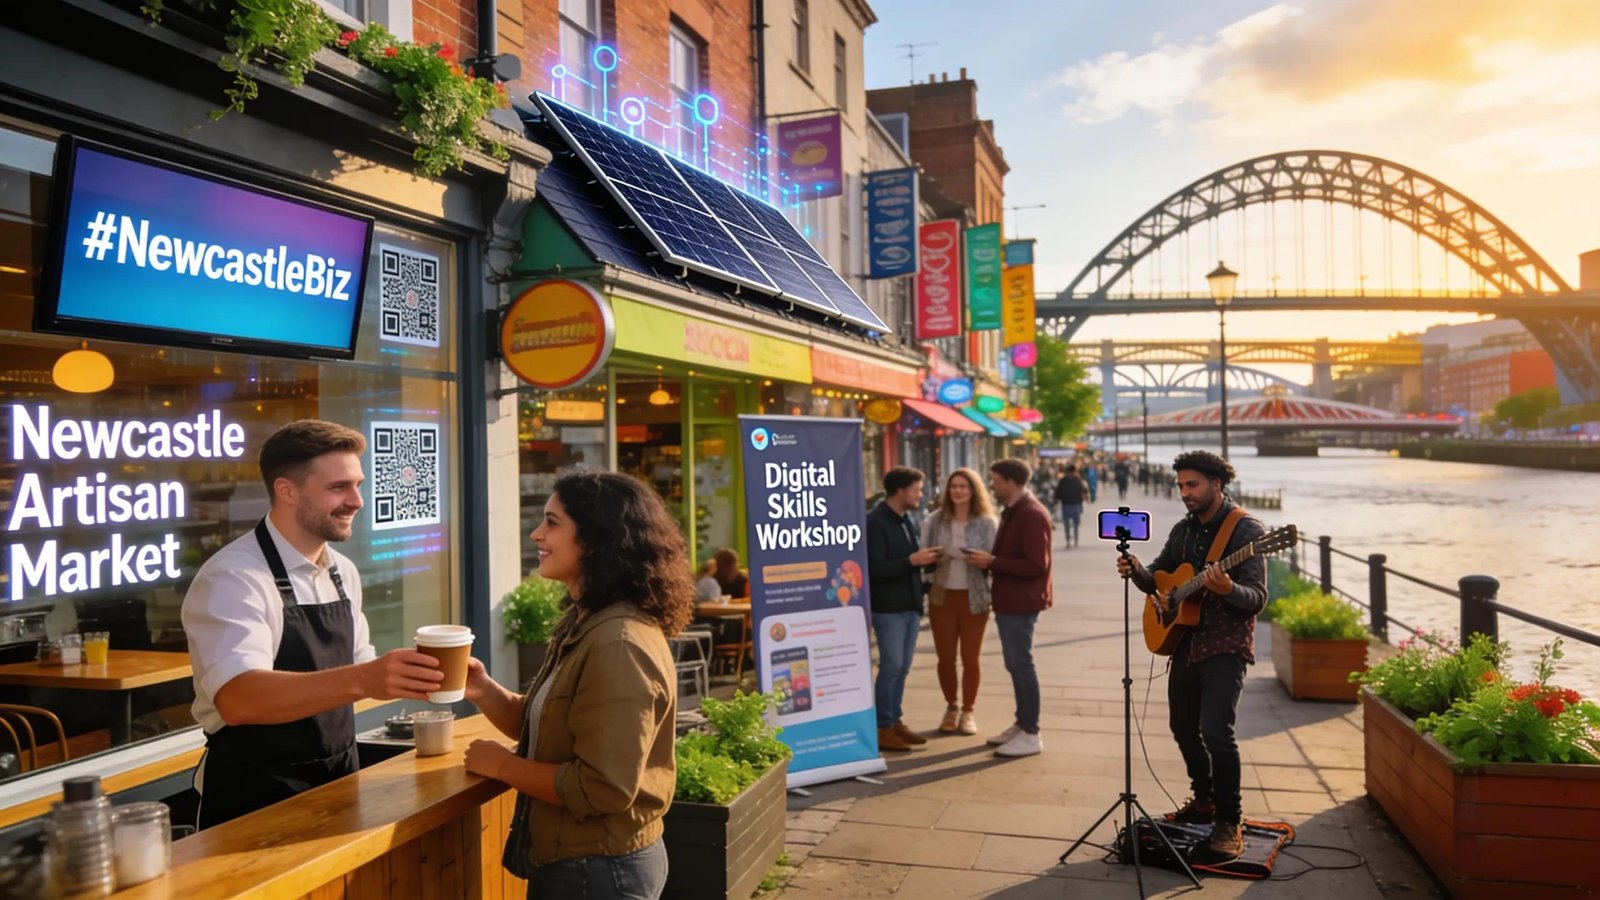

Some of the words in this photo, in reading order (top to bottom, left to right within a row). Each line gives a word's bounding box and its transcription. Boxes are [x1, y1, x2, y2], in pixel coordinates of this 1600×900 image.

[83, 211, 351, 300] #NewcastleBiz
[12, 405, 245, 460] Newcastle
[8, 473, 185, 531] Artisan
[765, 459, 836, 492] Digital
[768, 490, 828, 519] Skills
[755, 519, 861, 551] Workshop
[10, 532, 181, 600] Market
